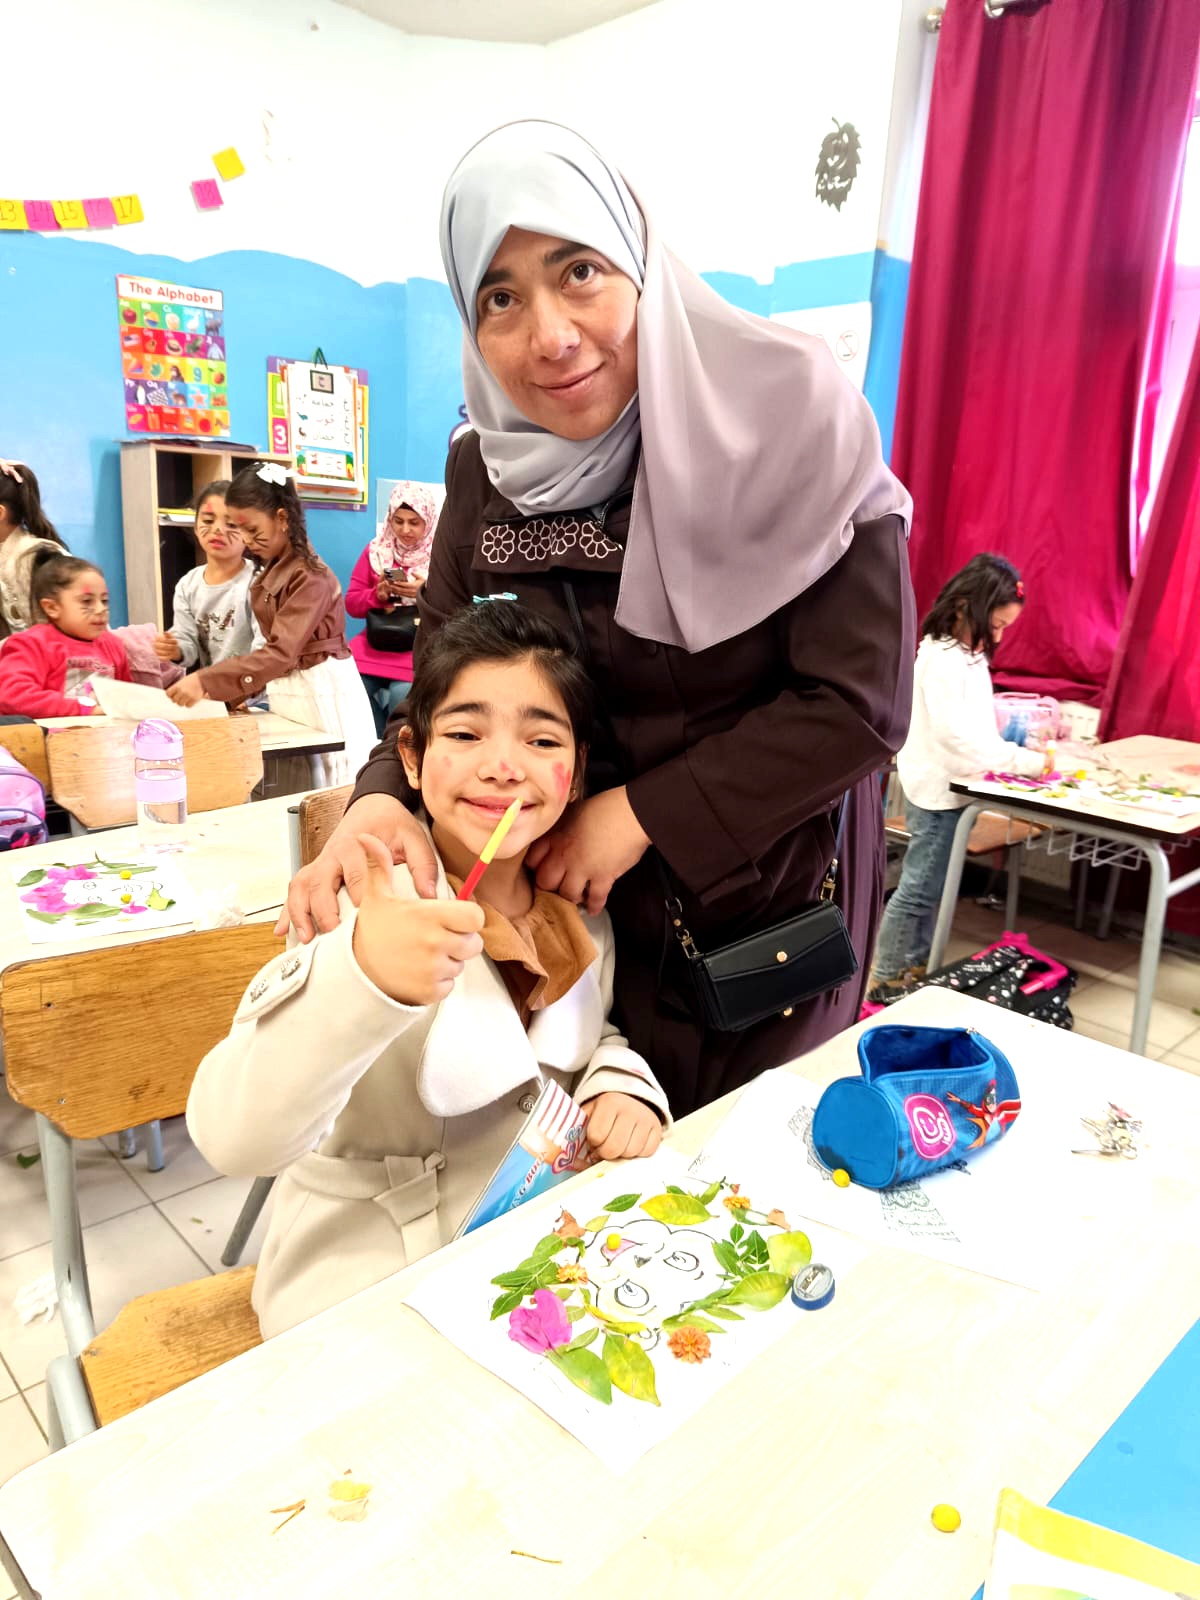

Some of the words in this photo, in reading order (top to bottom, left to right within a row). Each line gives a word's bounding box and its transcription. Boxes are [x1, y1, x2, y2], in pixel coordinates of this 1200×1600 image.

[29, 200, 51, 222] 14
[57, 200, 79, 221] 15
[117, 196, 133, 218] 17
[129, 281, 152, 296] The
[157, 286, 214, 305] Alphabet
[193, 367, 202, 382] 9
[274, 423, 287, 445] 3
